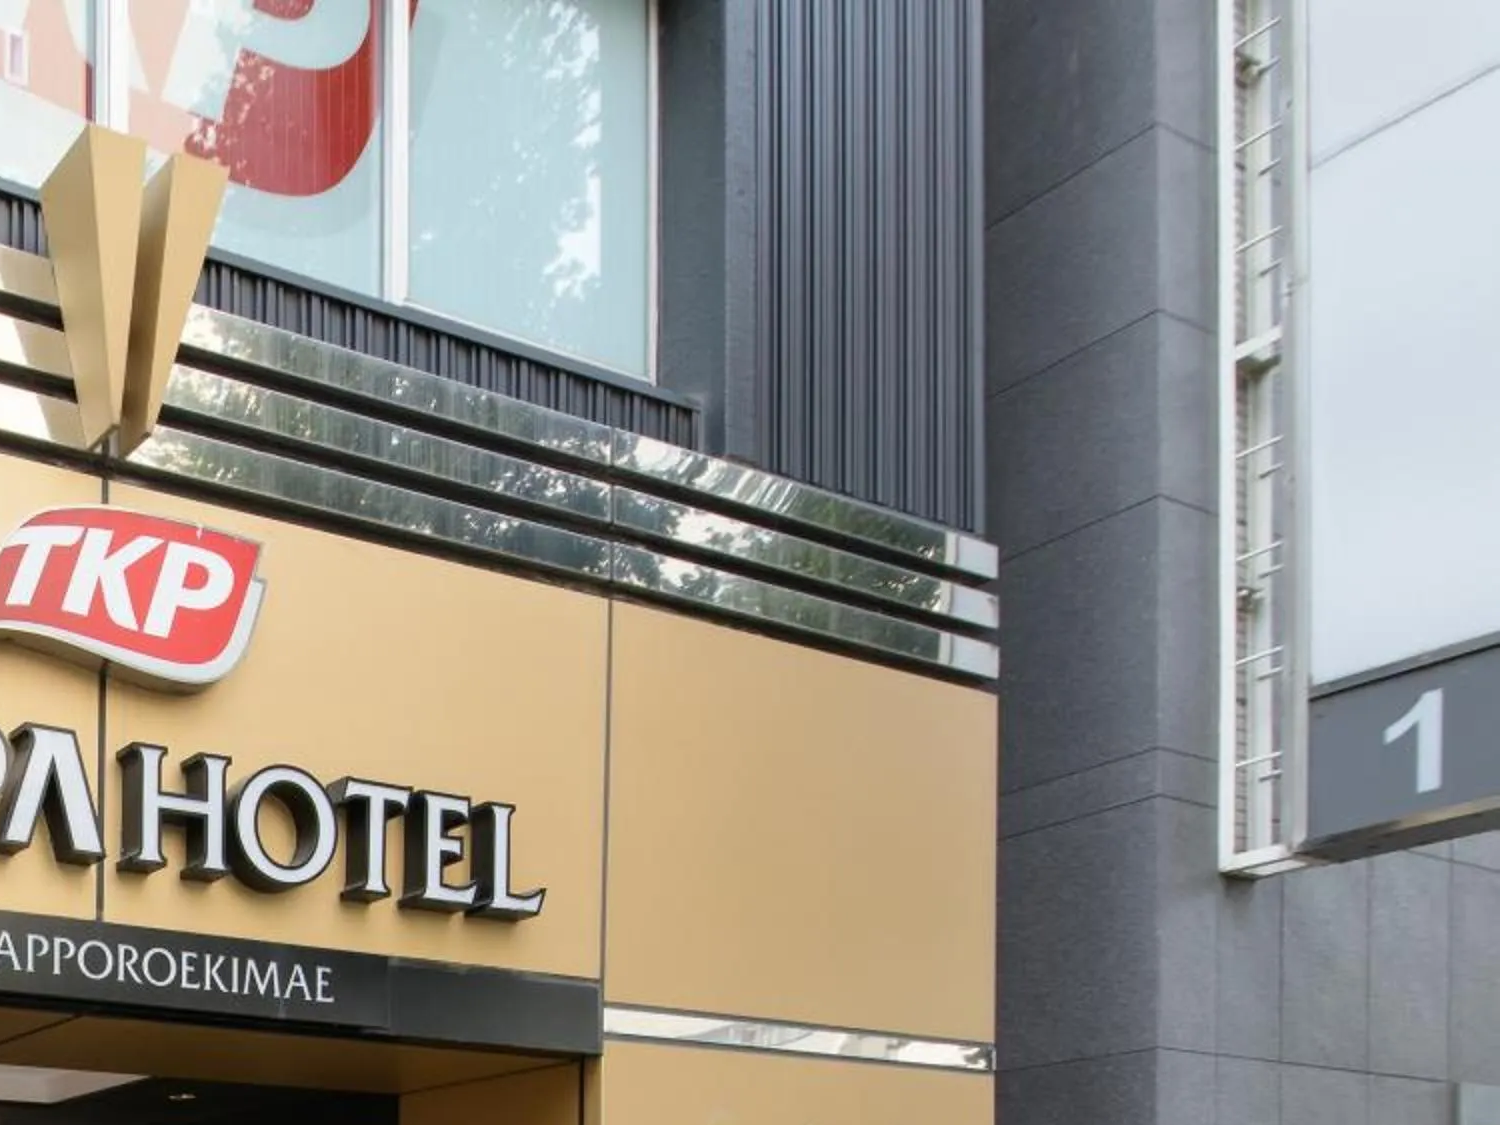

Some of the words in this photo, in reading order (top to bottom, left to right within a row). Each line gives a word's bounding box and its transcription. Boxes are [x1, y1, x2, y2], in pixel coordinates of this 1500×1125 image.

[4, 525, 235, 640] TKP
[1383, 687, 1443, 794] 1
[117, 741, 546, 920] HOTEL
